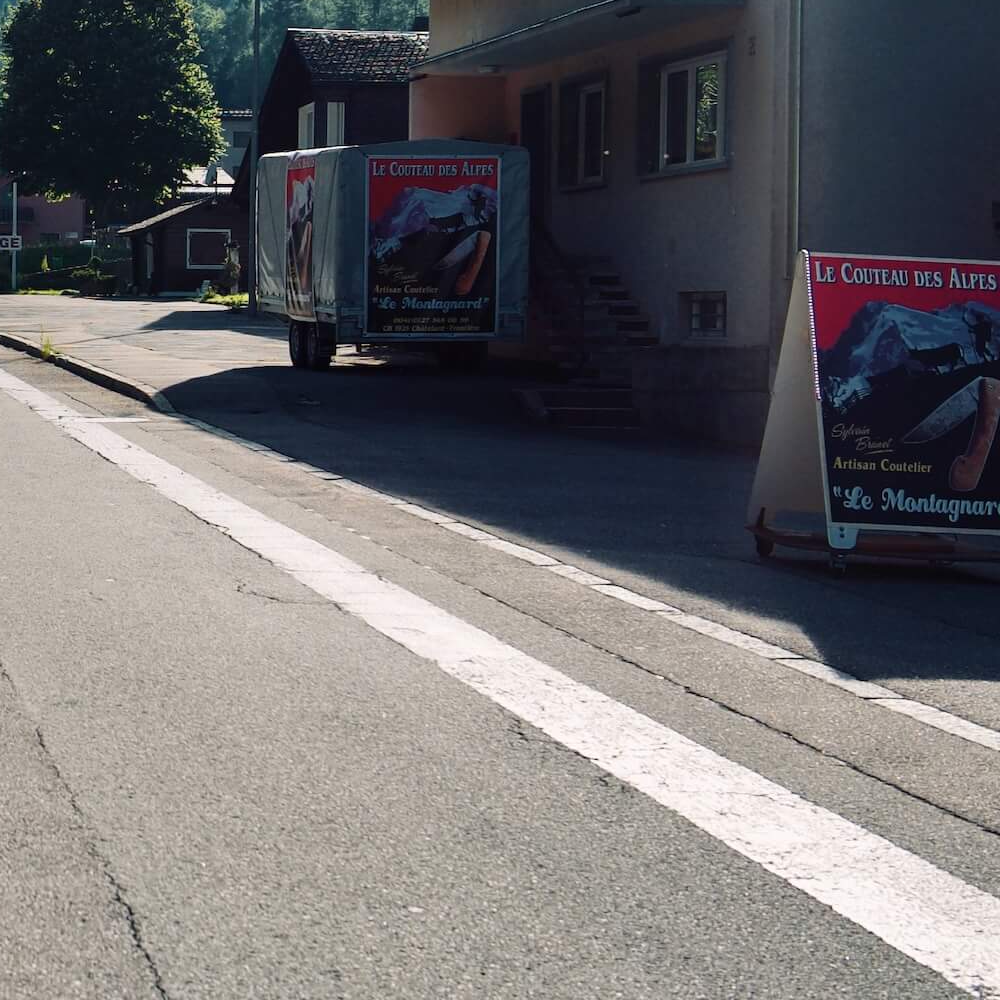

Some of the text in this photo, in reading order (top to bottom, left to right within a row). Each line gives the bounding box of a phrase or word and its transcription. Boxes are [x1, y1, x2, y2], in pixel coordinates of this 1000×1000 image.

[390, 161, 435, 177] COUTEAU
[461, 161, 494, 177] ALPES
[815, 261, 998, 291] LE COUTEAU DES ALPES
[833, 456, 932, 473] Artisan Coutelier
[881, 487, 1000, 521] Montagnar
